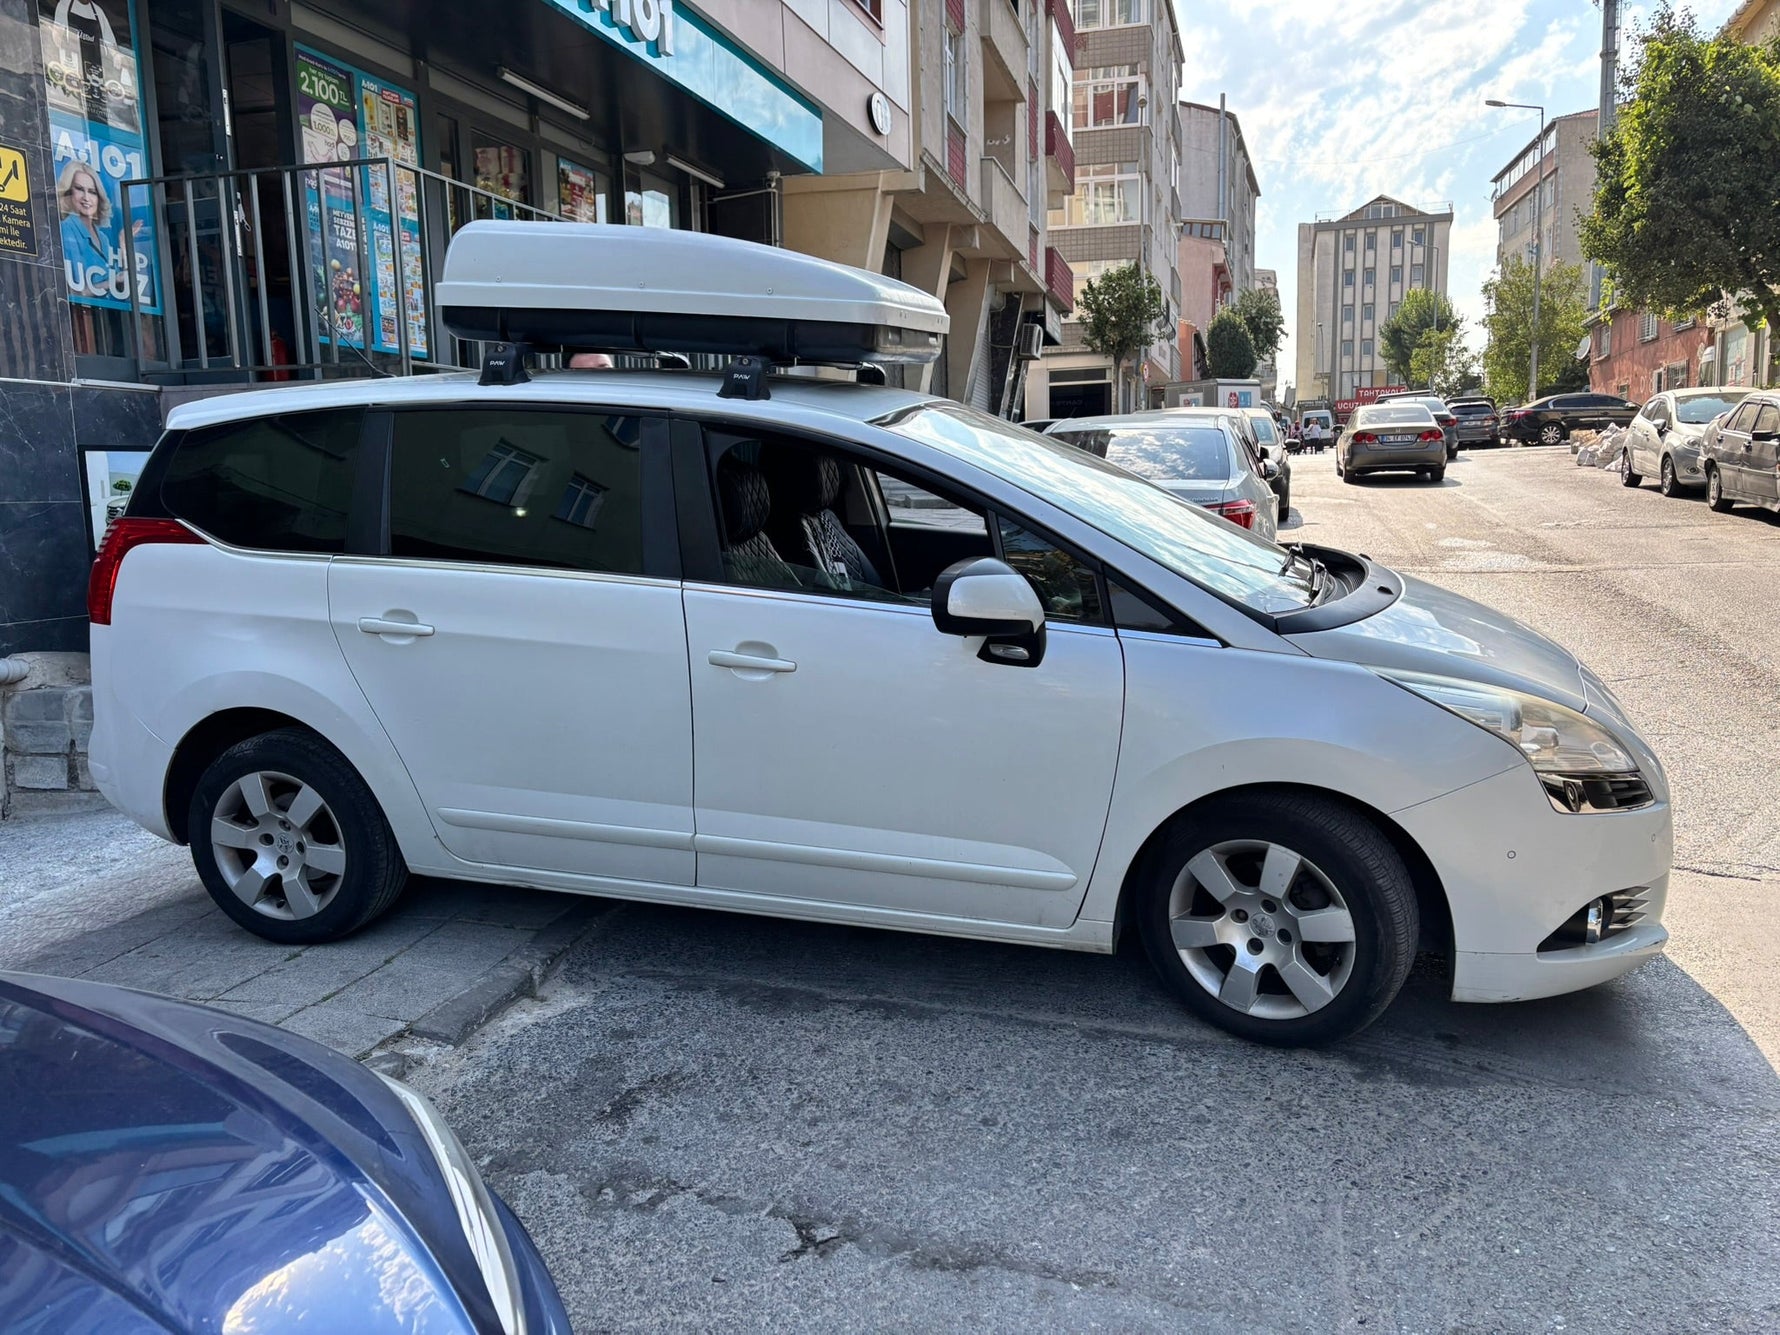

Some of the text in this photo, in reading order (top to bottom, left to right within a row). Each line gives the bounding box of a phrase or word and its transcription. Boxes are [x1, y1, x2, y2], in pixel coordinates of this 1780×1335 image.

[300, 71, 339, 104] 2.100
[2, 214, 31, 228] Kamera
[10, 205, 26, 216] Saat
[64, 259, 151, 304] UCUZ
